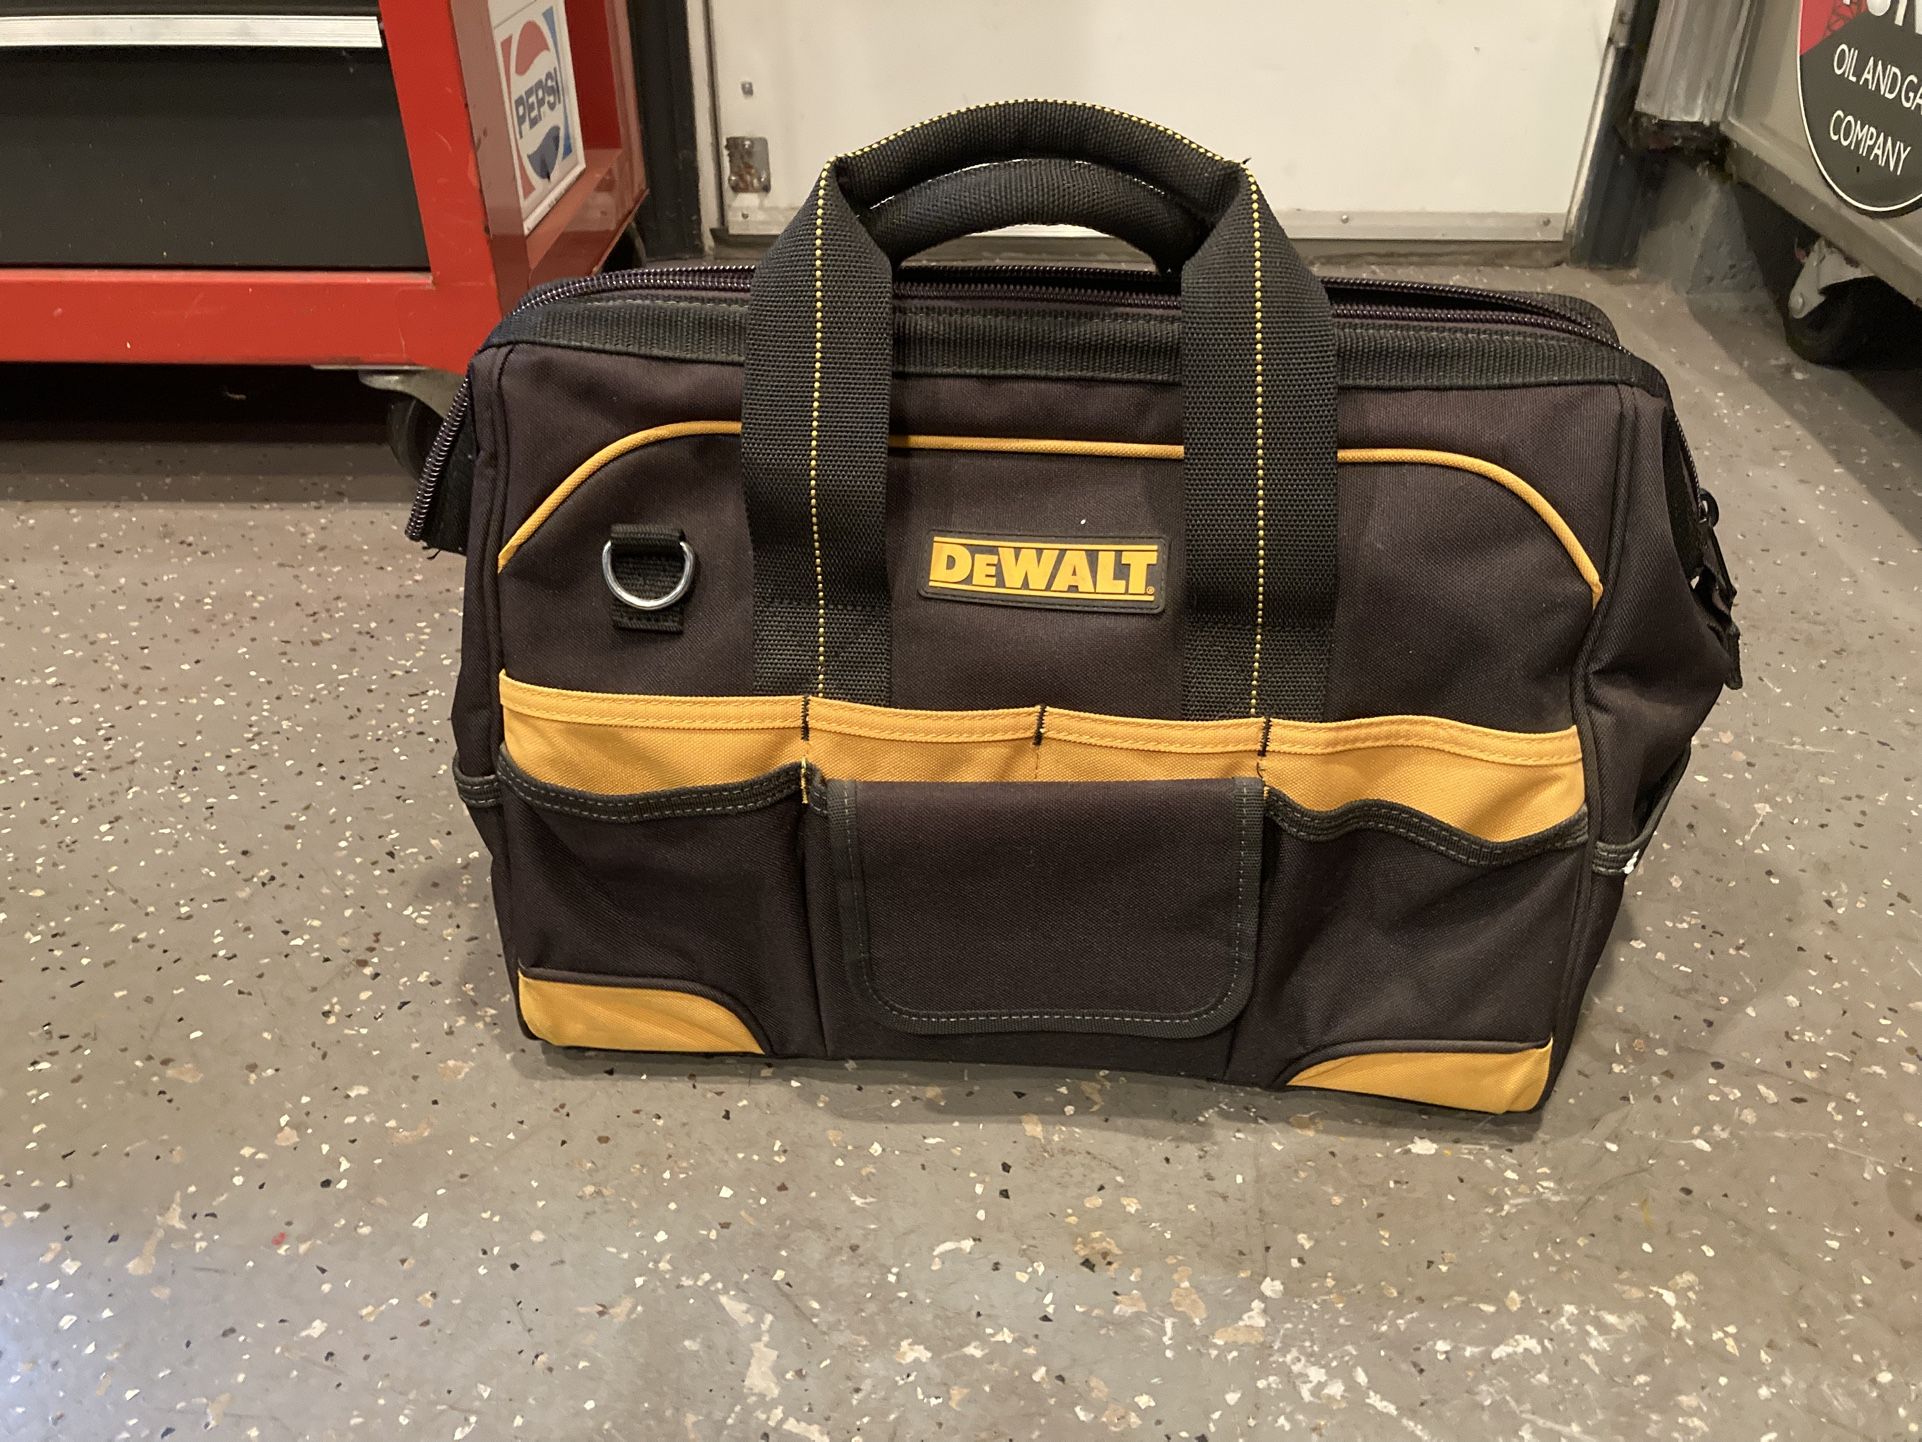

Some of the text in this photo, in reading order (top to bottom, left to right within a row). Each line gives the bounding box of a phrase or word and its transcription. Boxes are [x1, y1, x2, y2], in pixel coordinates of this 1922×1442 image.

[514, 67, 562, 139] PEPSI
[1833, 43, 1858, 82] OIL
[1859, 55, 1902, 99] AND
[1829, 110, 1911, 176] COMPANY
